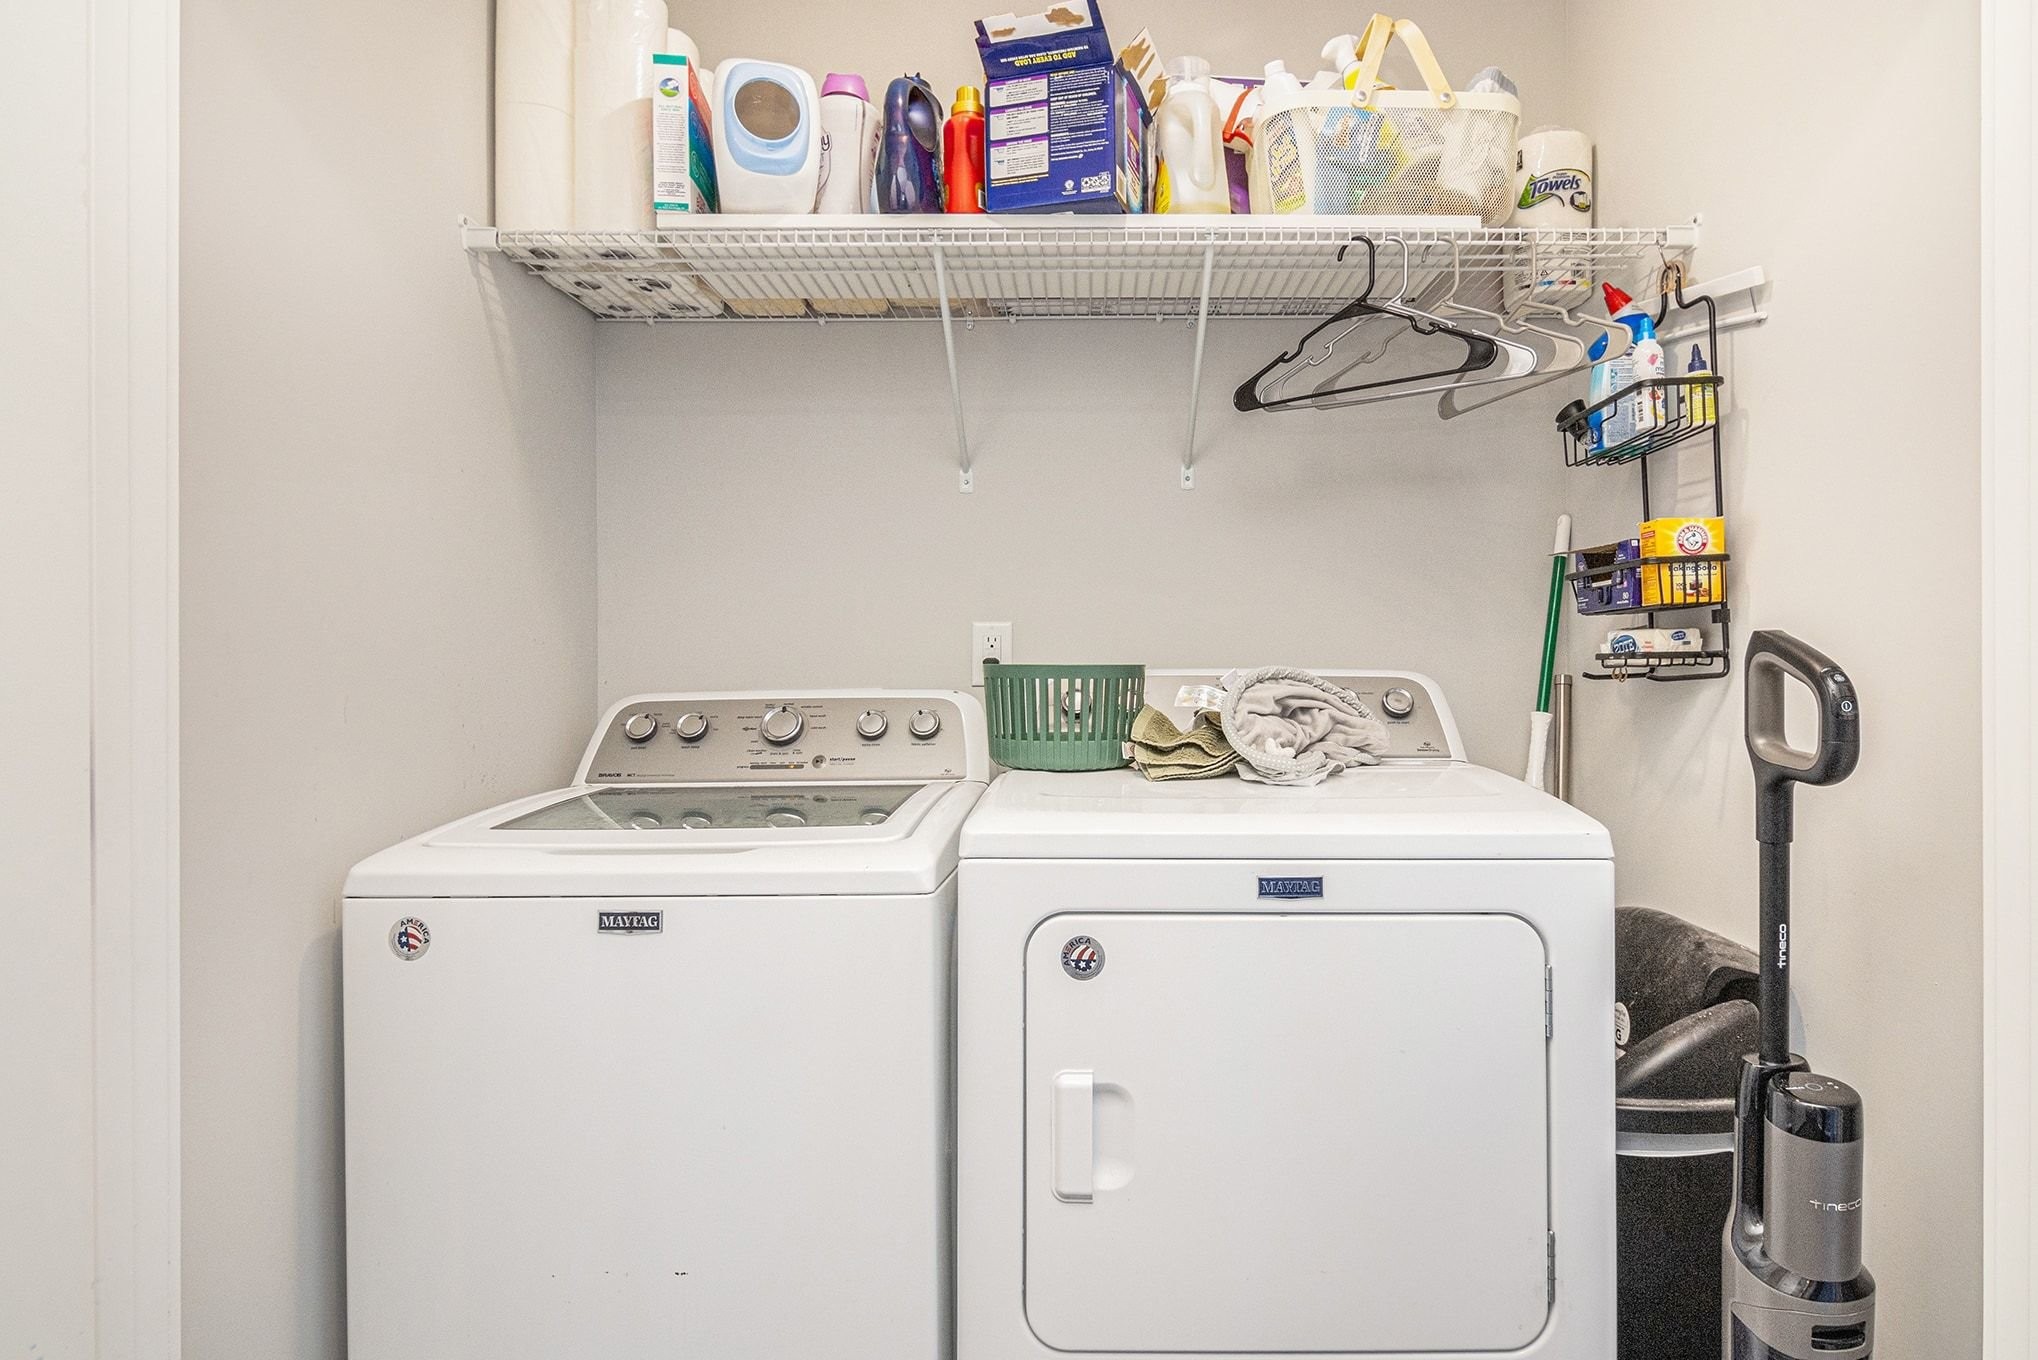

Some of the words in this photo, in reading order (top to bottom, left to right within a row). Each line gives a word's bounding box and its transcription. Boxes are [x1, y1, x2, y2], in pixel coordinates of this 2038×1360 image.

[1032, 55, 1052, 64] EVERY
[1052, 53, 1062, 61] TO
[1062, 50, 1077, 59] ADD
[1014, 58, 1031, 67] LOAD
[1529, 175, 1581, 200] Towels
[1261, 880, 1321, 893] MAYTAG
[601, 915, 659, 927] MAYTAG
[400, 918, 430, 945] AMERICA
[1062, 937, 1092, 967] AMERICA
